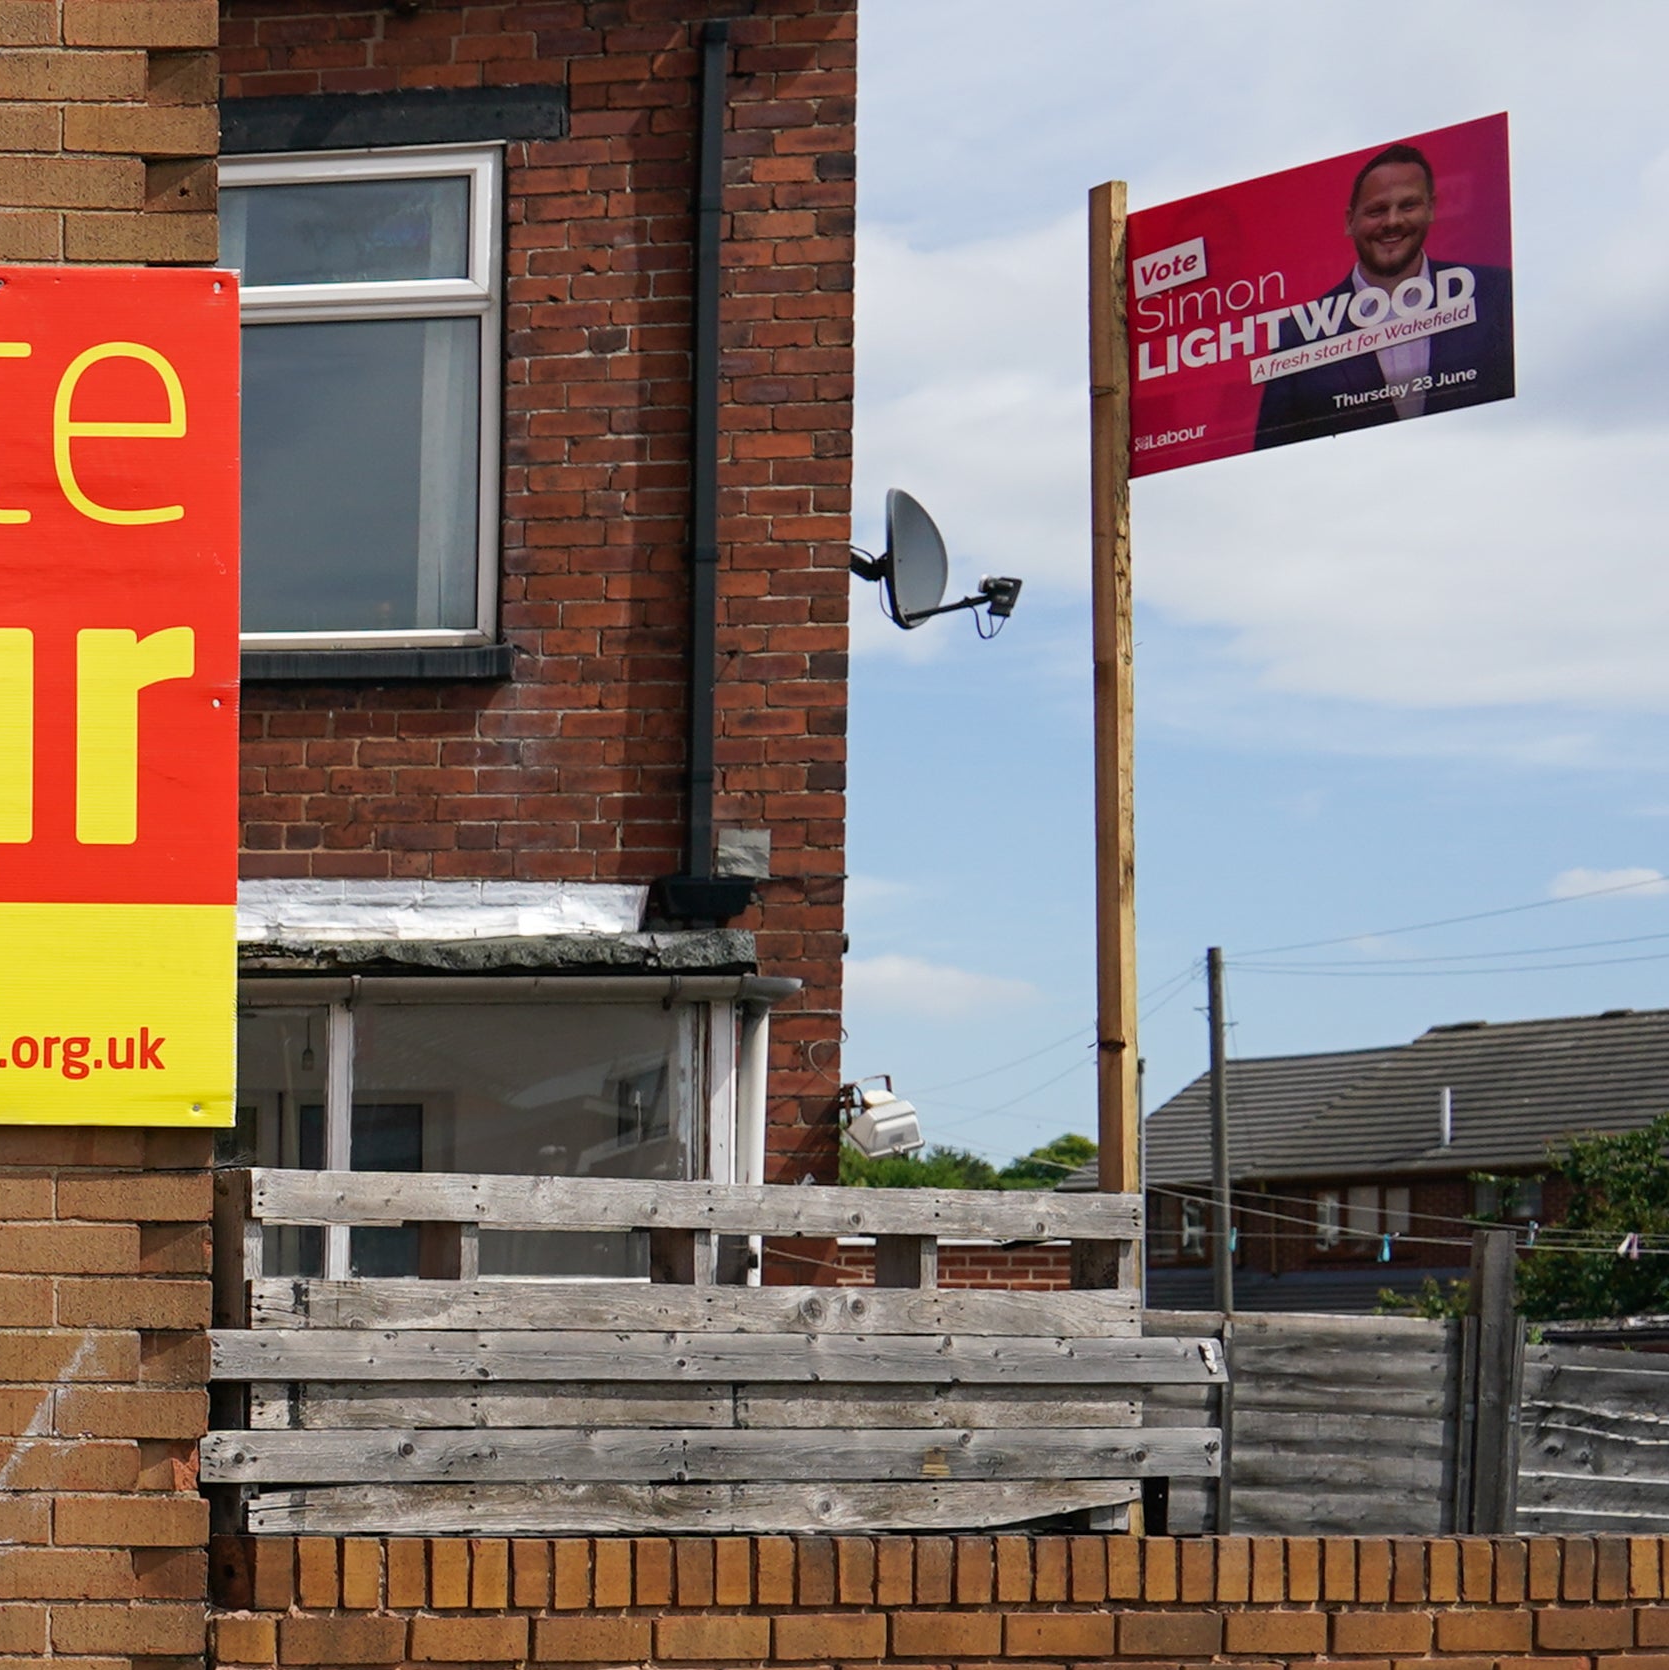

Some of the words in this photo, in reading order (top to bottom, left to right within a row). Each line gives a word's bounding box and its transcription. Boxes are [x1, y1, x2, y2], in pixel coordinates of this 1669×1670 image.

[1140, 251, 1198, 287] Vote
[1137, 271, 1285, 334] Simon
[1138, 267, 1476, 382] LIGHTWOOD
[1254, 363, 1267, 379] A
[1269, 351, 1310, 378] fresh
[1314, 338, 1353, 362] start
[1357, 332, 1381, 353] for
[1384, 304, 1470, 341] Wakefield
[1332, 382, 1409, 410] Thursday
[1412, 375, 1433, 392] 23
[1436, 368, 1478, 387] June
[1149, 422, 1207, 449] Labour
